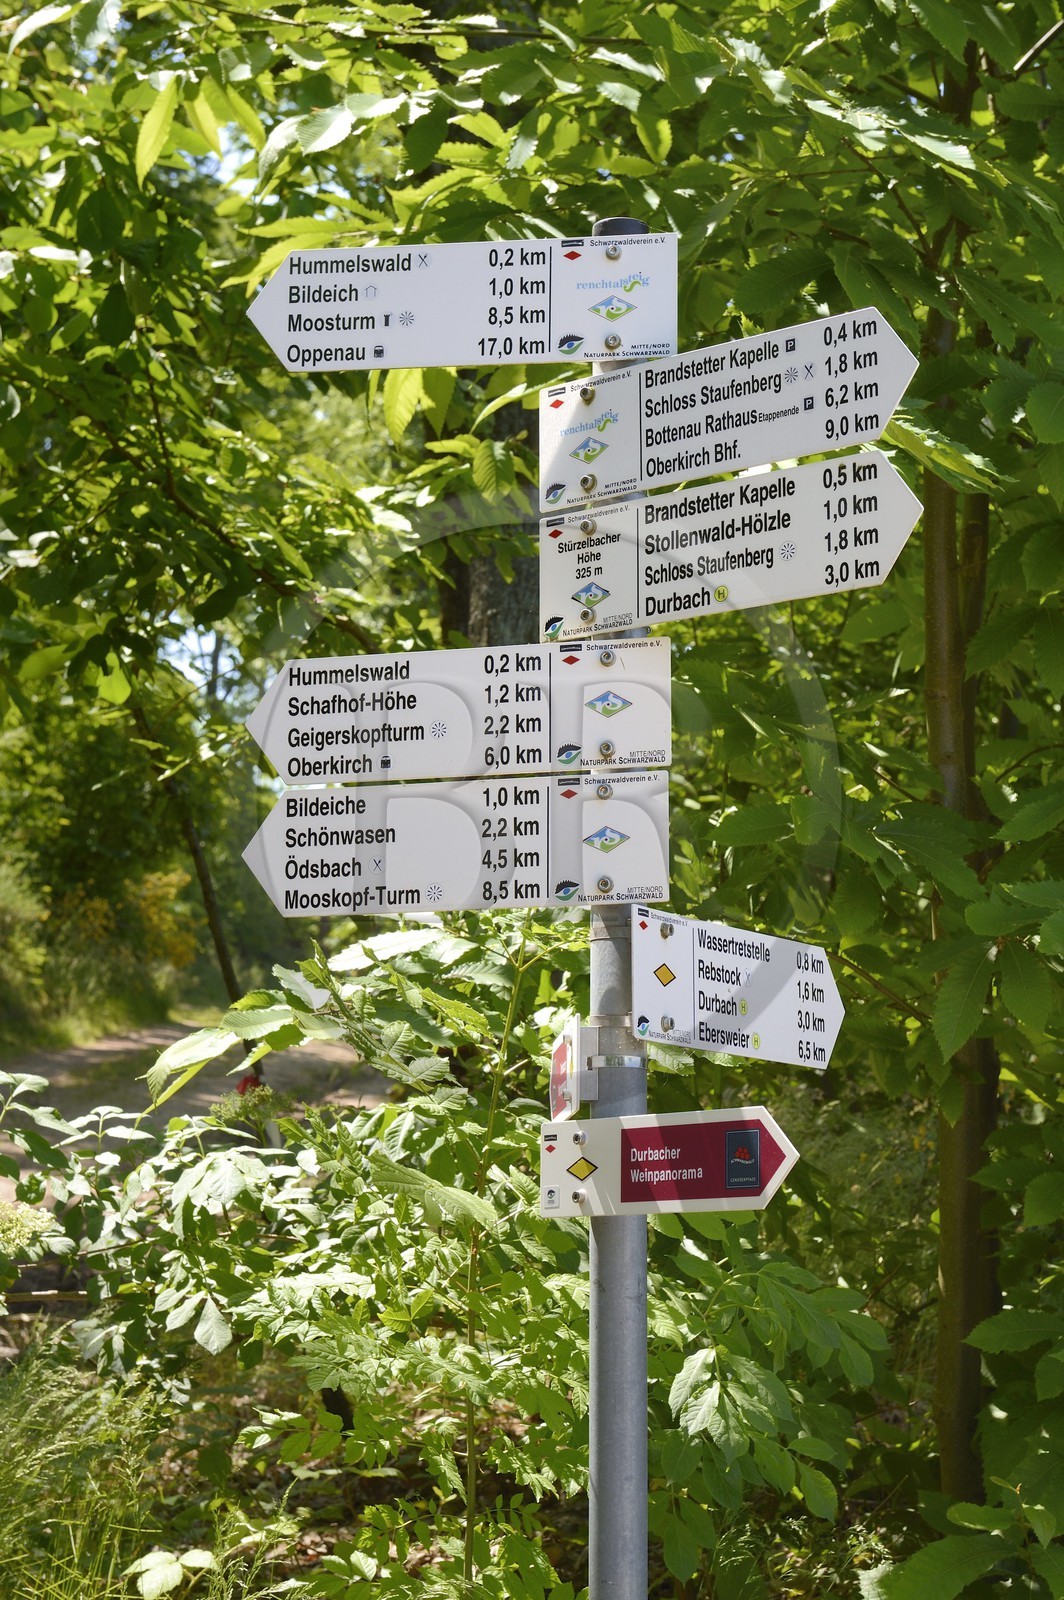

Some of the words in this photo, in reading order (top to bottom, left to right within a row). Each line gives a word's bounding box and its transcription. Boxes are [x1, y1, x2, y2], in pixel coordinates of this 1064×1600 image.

[590, 239, 653, 247] Schwarzwaldverein
[290, 254, 411, 274] Hummelswald
[489, 248, 513, 270] 0,2
[521, 248, 545, 265] km
[289, 284, 358, 303] Bildeich
[490, 278, 513, 298] 1,0
[520, 277, 545, 294] km
[576, 272, 649, 292] renchtalsteig
[288, 314, 374, 332] Moosturm
[489, 307, 513, 328] 8,5
[520, 306, 545, 323] km
[288, 345, 365, 366] Oppenau
[478, 337, 512, 358] 17,0
[520, 337, 544, 354] km
[645, 352, 725, 388] Brandstetter
[730, 341, 779, 369] Kapelle
[824, 323, 847, 348] 0,4
[853, 320, 876, 339] km
[622, 370, 632, 378] e.V.
[645, 394, 696, 418] Schloss
[701, 374, 781, 405] Staufenberg
[825, 354, 847, 378] 1,8
[854, 351, 877, 370] km
[560, 409, 619, 436] renchtalsteig
[646, 422, 700, 447] Bottenau
[706, 410, 757, 434] Rathaus
[759, 406, 799, 422] Etappenende
[826, 385, 848, 409] 6,2
[854, 382, 878, 400] km
[646, 447, 709, 477] Oberkirch
[715, 440, 740, 462] Bhf.
[826, 416, 848, 440] 9,0
[855, 414, 878, 432] km
[567, 493, 596, 504] NATURPARK
[597, 485, 637, 498] SCHWARZWALD
[645, 492, 734, 524] Brandstetter
[740, 477, 795, 506] Kapelle
[823, 464, 847, 491] 0,5
[853, 463, 877, 482] km
[568, 507, 619, 523] Schwarzwaldverein
[620, 505, 630, 513] e.V.
[645, 509, 791, 554] Stollenwald-Hölzle
[824, 498, 847, 522] 1,0
[853, 495, 877, 514] km
[558, 534, 620, 554] Stürzelbacher
[578, 552, 601, 564] Höhe
[645, 562, 693, 586] Schloss
[698, 548, 773, 576] Staufenberg
[825, 530, 848, 555] 1,8
[854, 527, 878, 547] km
[576, 567, 591, 579] 325
[594, 567, 602, 575] m
[646, 587, 710, 616] Durbach
[825, 562, 849, 587] 3,0
[855, 560, 879, 579] km
[563, 626, 592, 636] NATURPARK
[594, 619, 632, 631] SCHWARZWALD
[586, 641, 648, 651] Schwarzwaldverein
[290, 661, 409, 686] Hummelswald
[485, 654, 509, 677] 0,2
[516, 653, 541, 672] km
[288, 691, 416, 716] Schafhof-Höhe
[485, 684, 509, 707] 1,2
[516, 684, 540, 702] km
[288, 723, 424, 751] Geigerskopfturm
[484, 715, 509, 738] 2,2
[516, 714, 541, 733] km
[288, 754, 372, 777] Oberkirch
[485, 746, 510, 769] 6,0
[517, 745, 541, 764] km
[580, 758, 617, 766] NATURPARK
[619, 756, 665, 764] SCHWARZWALD
[584, 776, 646, 785] Schwarzwaldverein
[287, 796, 366, 817] Bildeiche
[483, 787, 508, 810] 1,0
[514, 786, 539, 805] km
[286, 827, 395, 848] Schönwasen
[482, 818, 507, 841] 2,2
[514, 817, 539, 836] km
[286, 855, 361, 879] Ödsbach
[482, 849, 507, 872] 4,5
[514, 848, 539, 867] km
[285, 886, 420, 912] Mooskopf-Turm
[483, 880, 508, 904] 8,5
[515, 880, 540, 899] km
[616, 892, 663, 901] SCHWARZWALD
[698, 928, 770, 962] Wassertretstelle
[797, 951, 809, 973] 0,8
[812, 954, 823, 974] km
[699, 959, 741, 986] Rebstock
[798, 981, 809, 1002] 1,6
[812, 983, 824, 1002] km
[699, 991, 737, 1016] Durbach
[798, 1010, 810, 1032] 3,0
[813, 1013, 824, 1032] km
[699, 1022, 749, 1048] Ebersweier
[799, 1040, 810, 1062] 6,5
[814, 1042, 825, 1062] km
[632, 1147, 680, 1161] Durbacher
[631, 1168, 702, 1184] Weinpanorama
